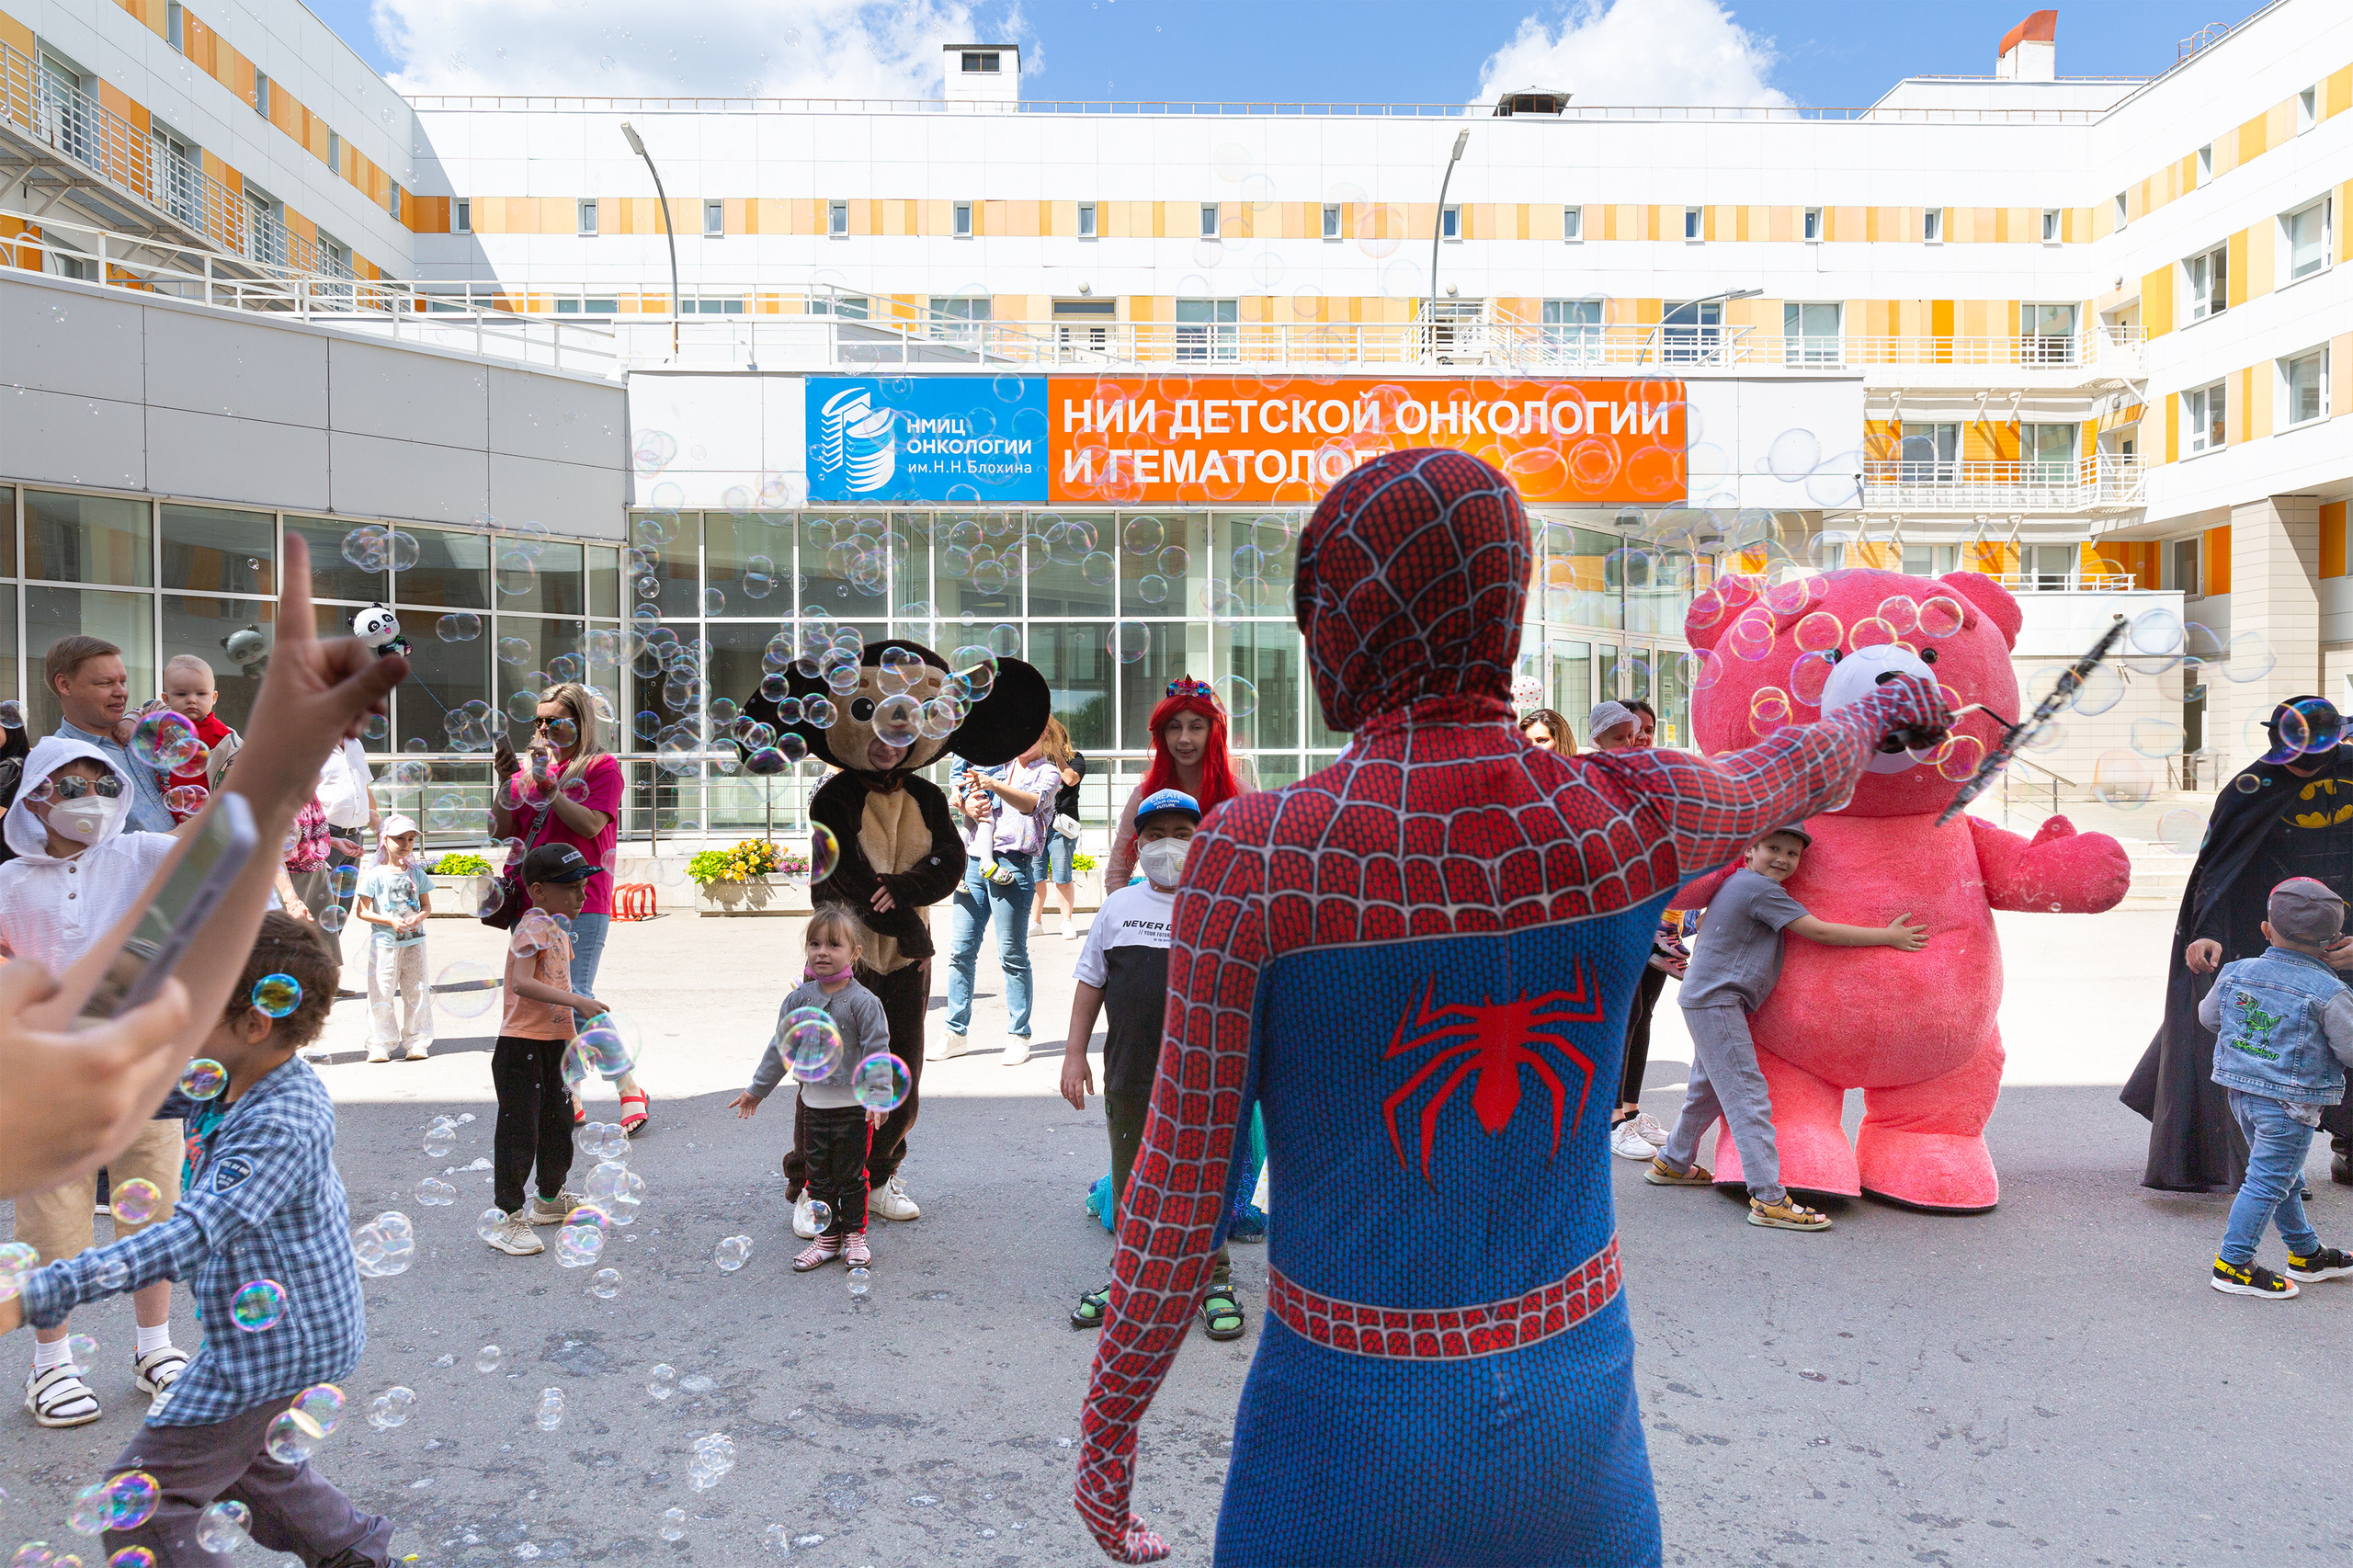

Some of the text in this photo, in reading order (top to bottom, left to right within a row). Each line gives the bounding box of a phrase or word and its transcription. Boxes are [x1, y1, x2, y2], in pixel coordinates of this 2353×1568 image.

[1063, 391, 1669, 440] НИИ ДЕТСКОЙ ОНКОЛОГИИ
[906, 418, 966, 437] НМИЦ
[906, 438, 1032, 454] ОНКОЛОГИИ
[1063, 449, 1386, 484] И ГЕМАТОЛОГ
[1150, 792, 1183, 803] CREATE
[1122, 920, 1165, 930] NEVER
